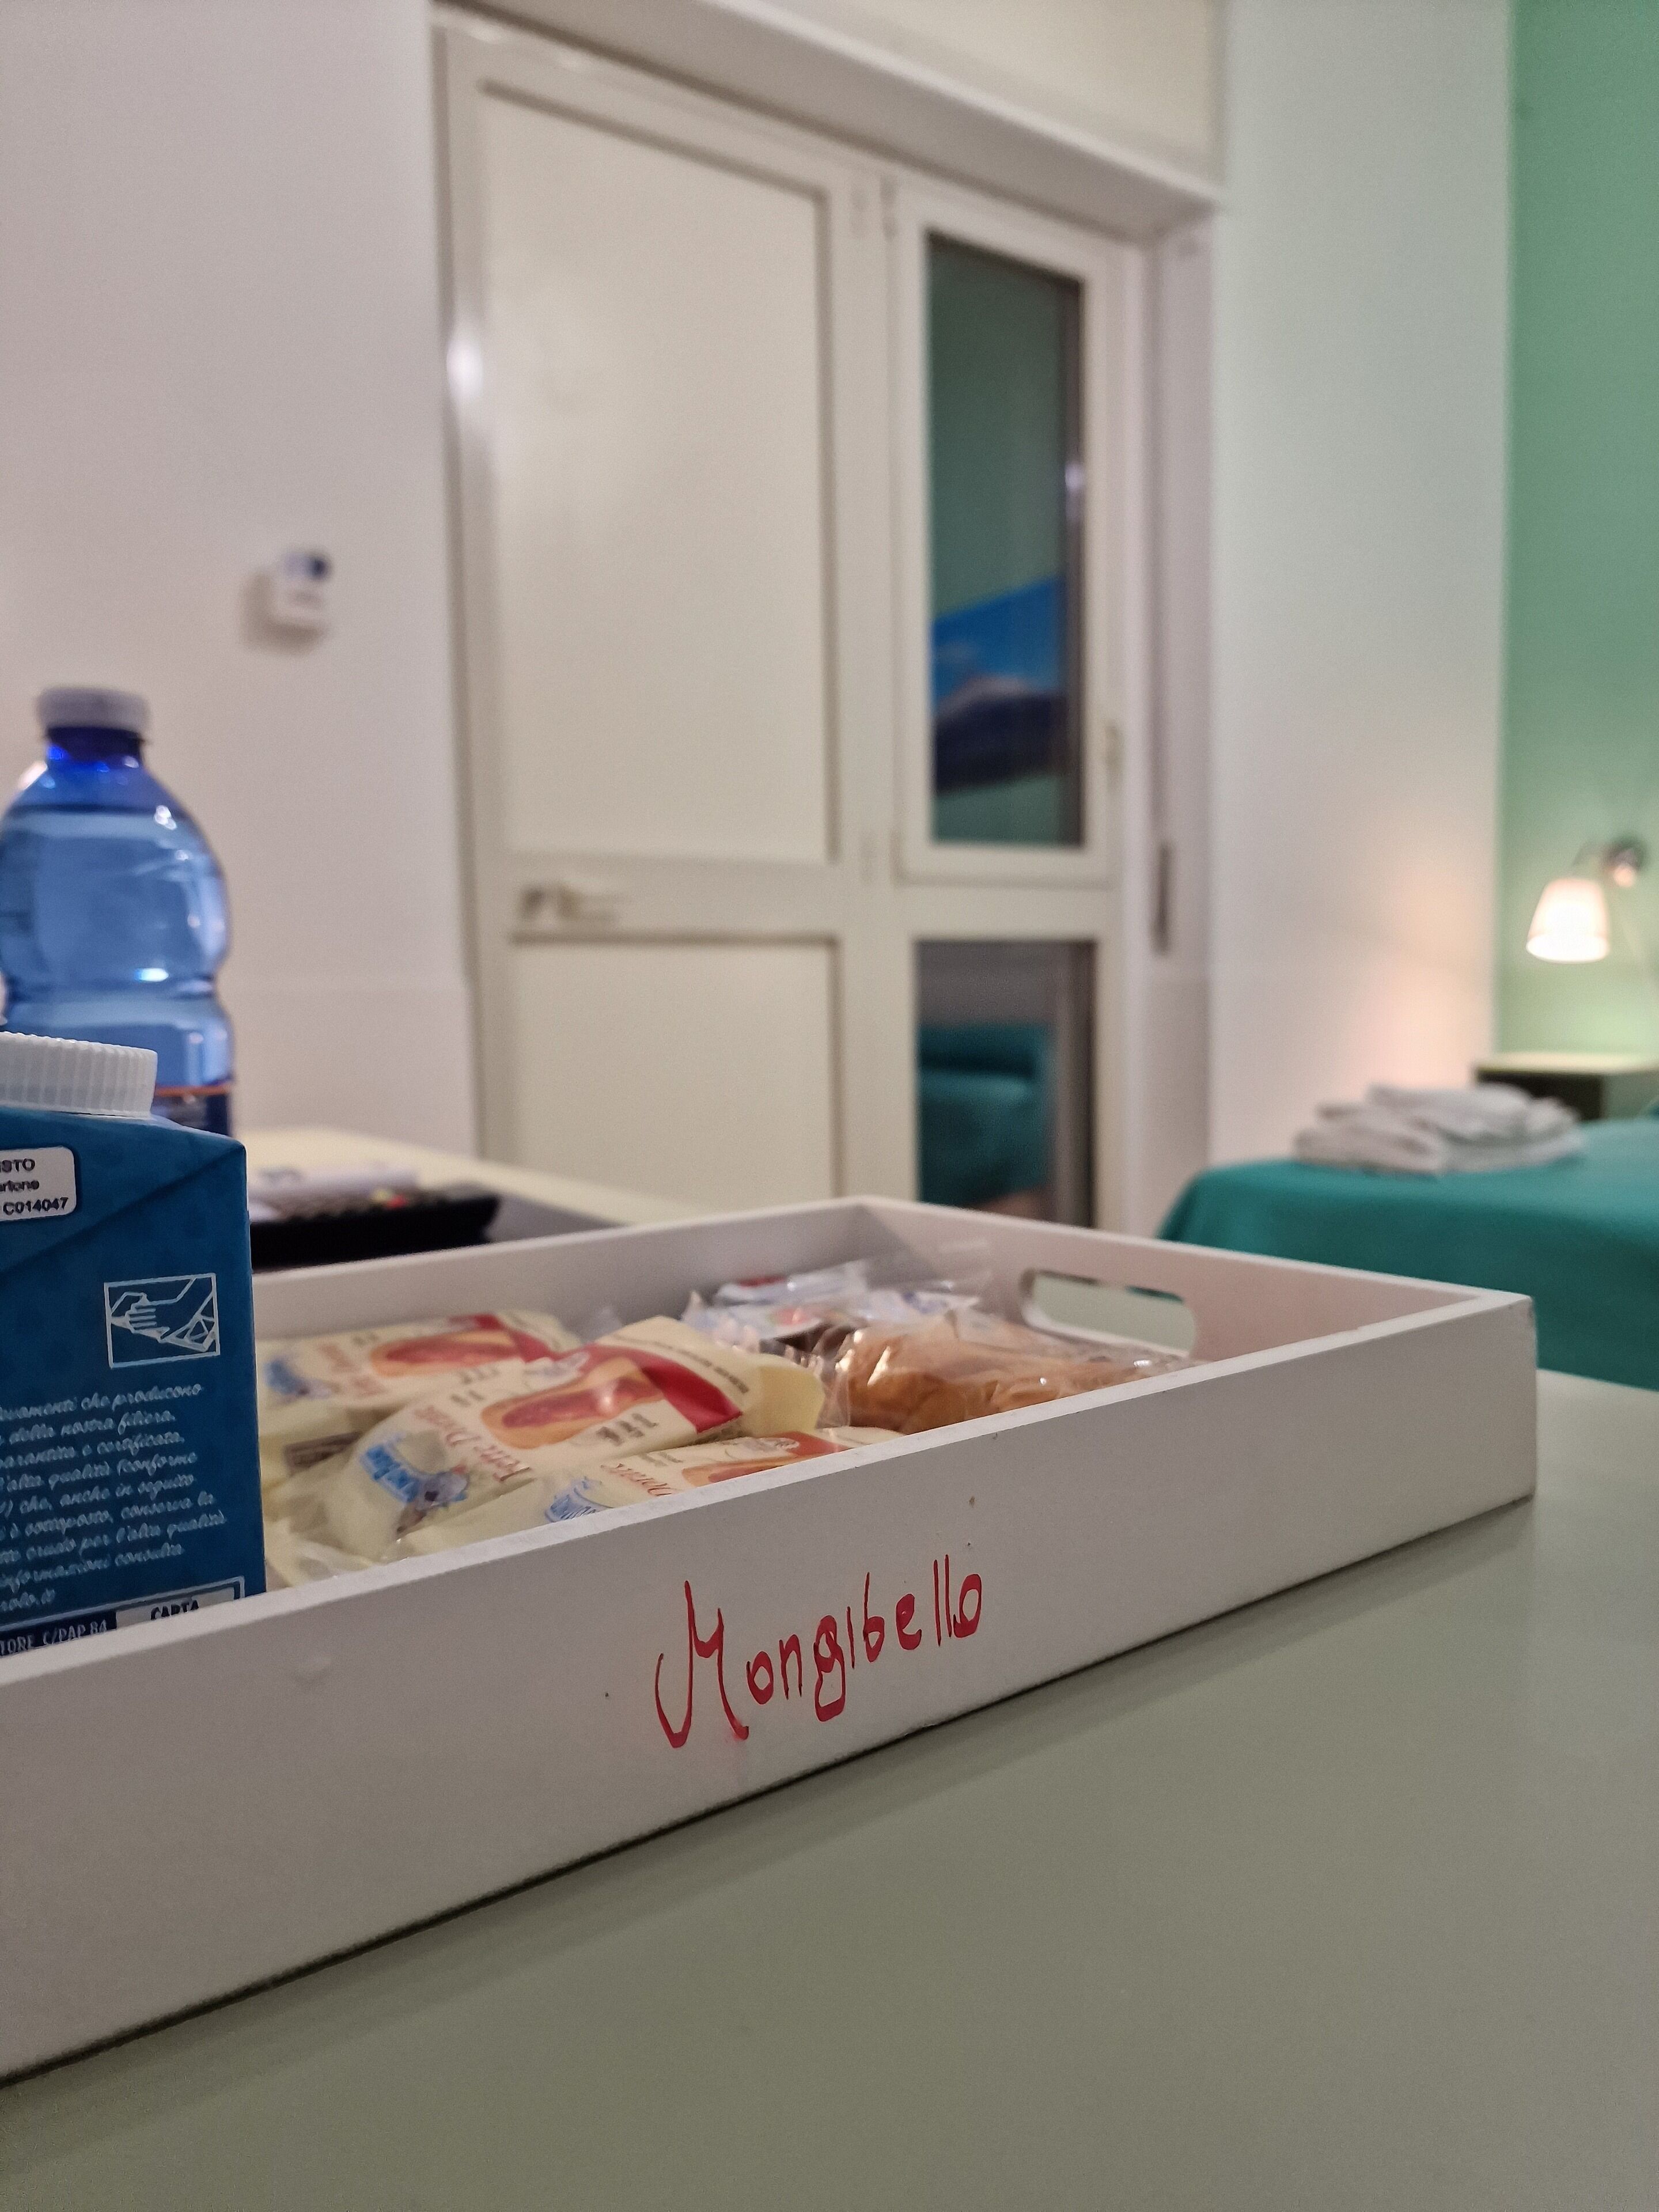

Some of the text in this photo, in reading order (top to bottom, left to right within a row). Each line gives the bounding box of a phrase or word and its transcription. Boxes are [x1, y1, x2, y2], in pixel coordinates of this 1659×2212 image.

[0, 1158, 35, 1173] STO
[3, 1196, 69, 1215] C014047
[81, 1392, 111, 1410] che
[112, 1384, 203, 1411] producono
[9, 1423, 56, 1445] della
[60, 1417, 115, 1436] nostra
[48, 1460, 110, 1491] qualità
[116, 1452, 197, 1476] (conforme
[60, 1485, 110, 1507] anche
[116, 1483, 133, 1498] in
[138, 1474, 196, 1500] seguito
[121, 1498, 193, 1520] conserva
[198, 1490, 215, 1507] la
[26, 1537, 77, 1560] crudo
[79, 1534, 111, 1556] per
[116, 1522, 161, 1544] l'alta
[115, 1542, 185, 1567] consulta
[654, 1554, 983, 1749] Mongibello
